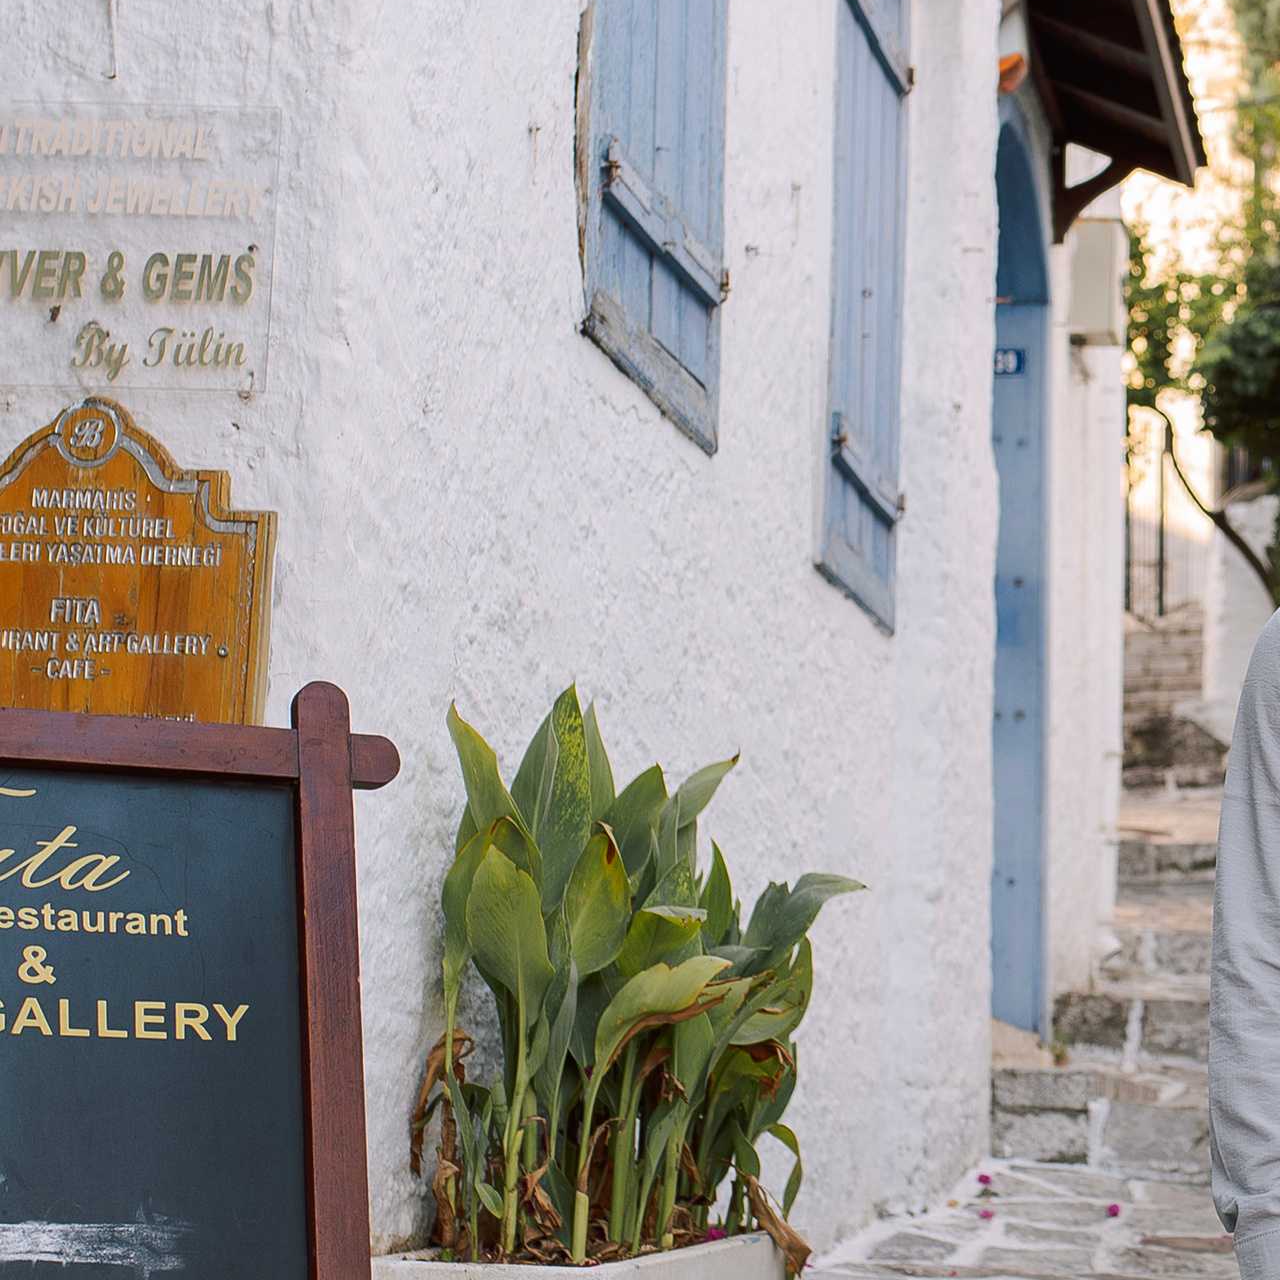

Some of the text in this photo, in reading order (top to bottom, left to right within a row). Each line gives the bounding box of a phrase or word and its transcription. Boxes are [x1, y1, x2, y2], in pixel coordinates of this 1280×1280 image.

[14, 118, 212, 160] TRADITIONAL
[87, 178, 267, 218] JEWELLERY
[100, 251, 126, 300] &
[142, 252, 256, 302] GEMS
[71, 322, 131, 381] By
[32, 486, 138, 511] MARMARİS
[54, 515, 79, 537] VE
[83, 512, 177, 539] KÜLTÜREL
[46, 540, 136, 567] YAŞATMA
[140, 542, 222, 567] DERNEĞİ
[50, 597, 101, 624] FITA
[65, 631, 80, 652] &
[84, 631, 121, 653] ART
[126, 633, 212, 656] GALLERY
[46, 658, 96, 680] CAFE
[17, 945, 57, 985] &
[0, 997, 250, 1041] ALLERY
